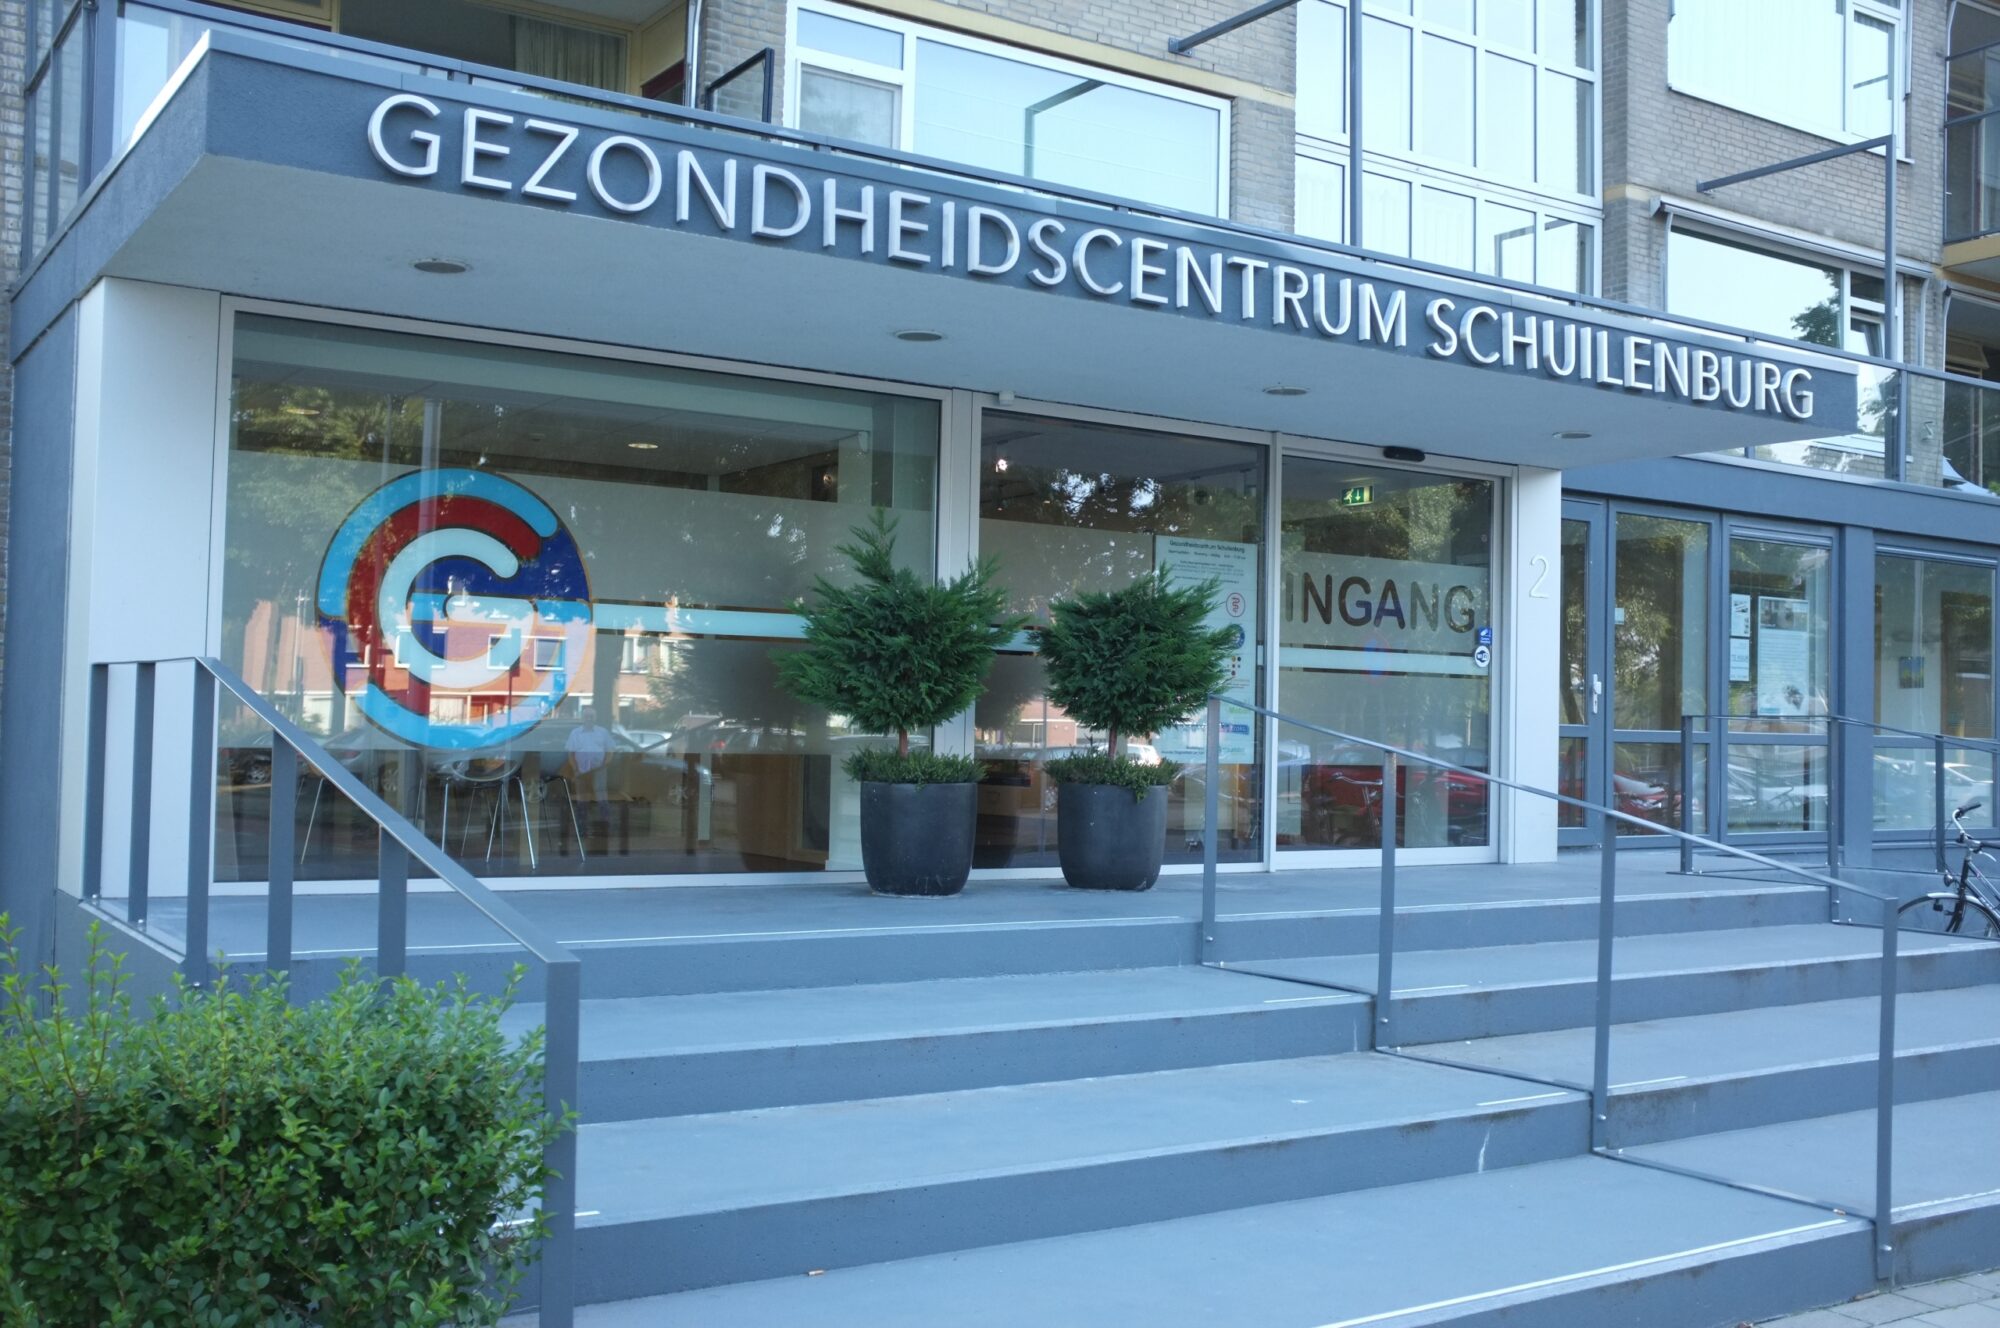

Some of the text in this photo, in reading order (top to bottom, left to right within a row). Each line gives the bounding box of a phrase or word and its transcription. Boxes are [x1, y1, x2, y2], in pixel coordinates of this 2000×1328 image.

[367, 93, 1814, 419] GEZONDHEIDSCENTRUM SCHUILENBURG
[1529, 554, 1550, 599] 2
